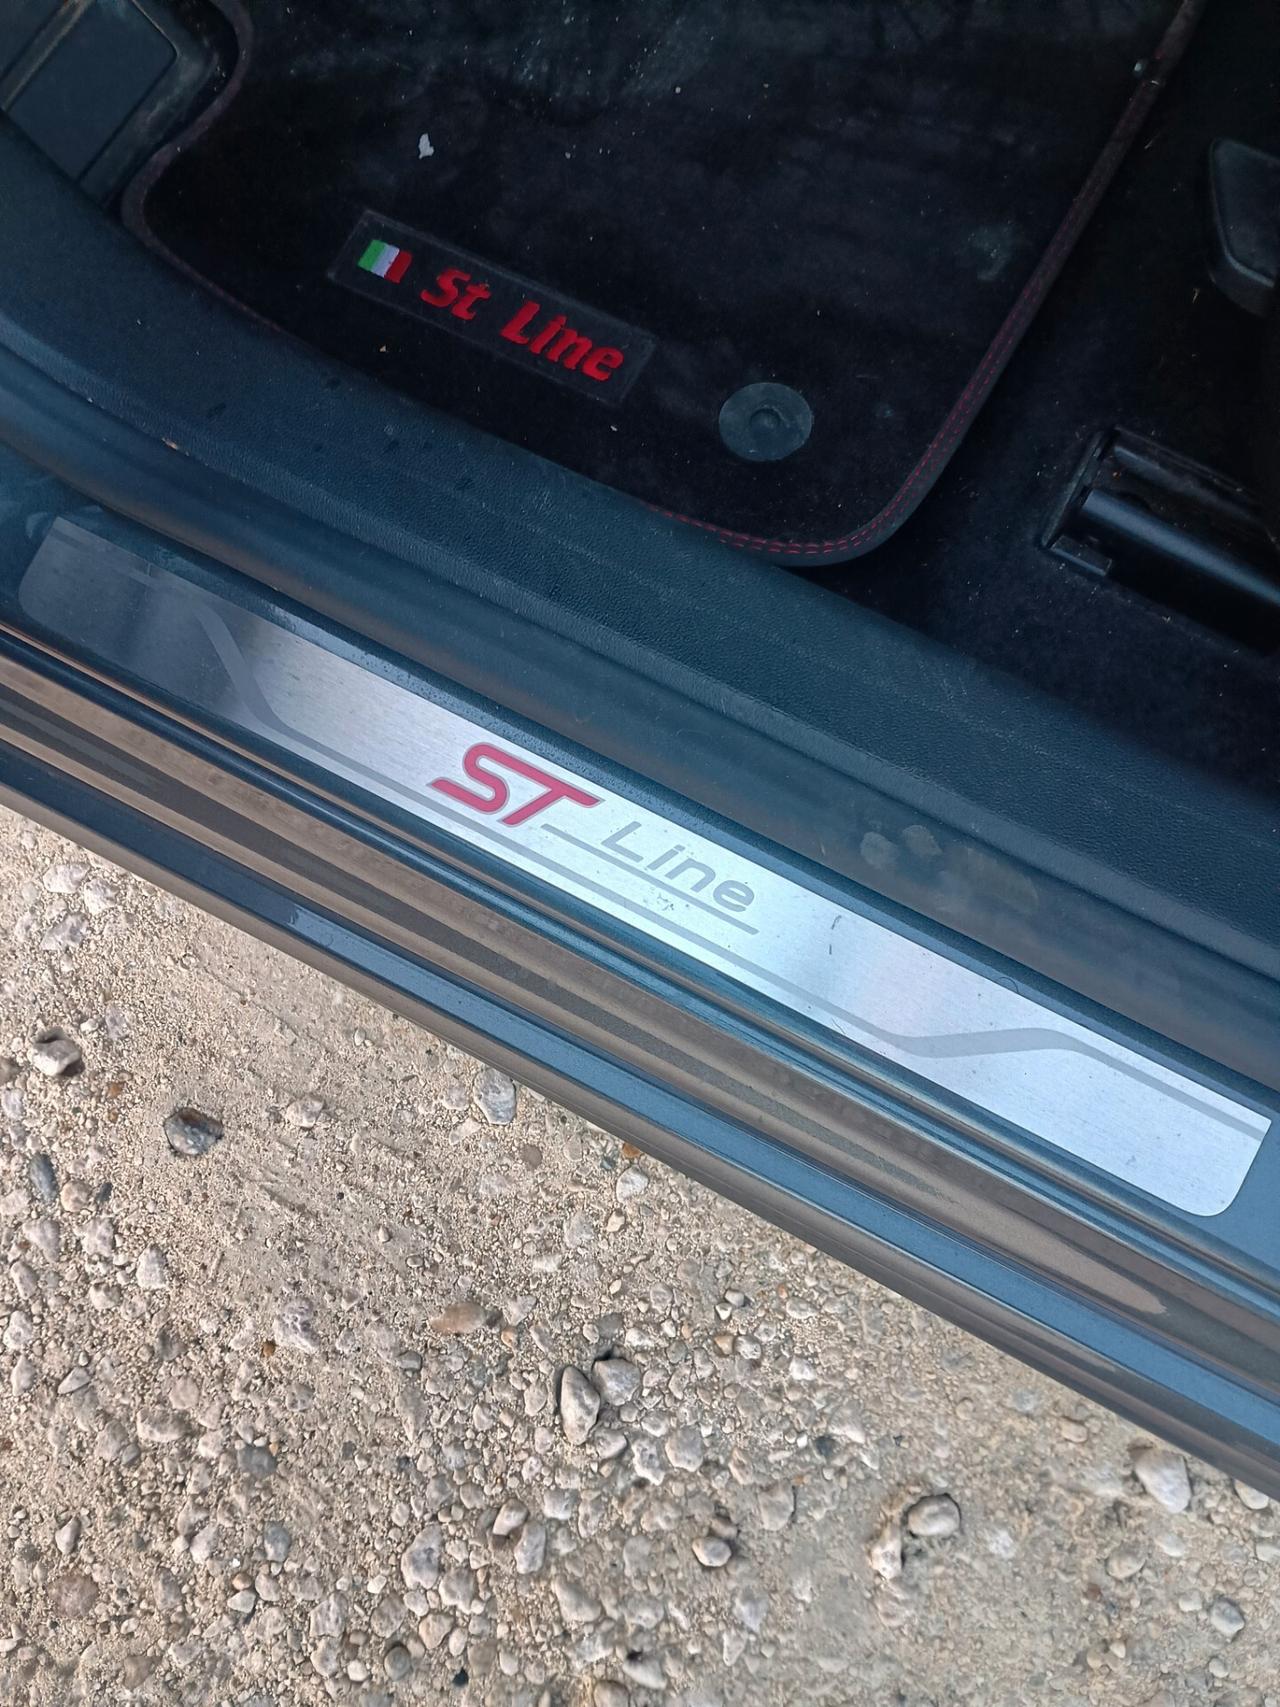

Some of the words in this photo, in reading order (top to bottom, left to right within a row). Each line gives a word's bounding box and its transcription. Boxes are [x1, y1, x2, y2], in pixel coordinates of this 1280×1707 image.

[420, 267, 491, 320] St
[499, 300, 624, 381] Line
[428, 742, 604, 826] ST
[600, 821, 755, 912] Line
